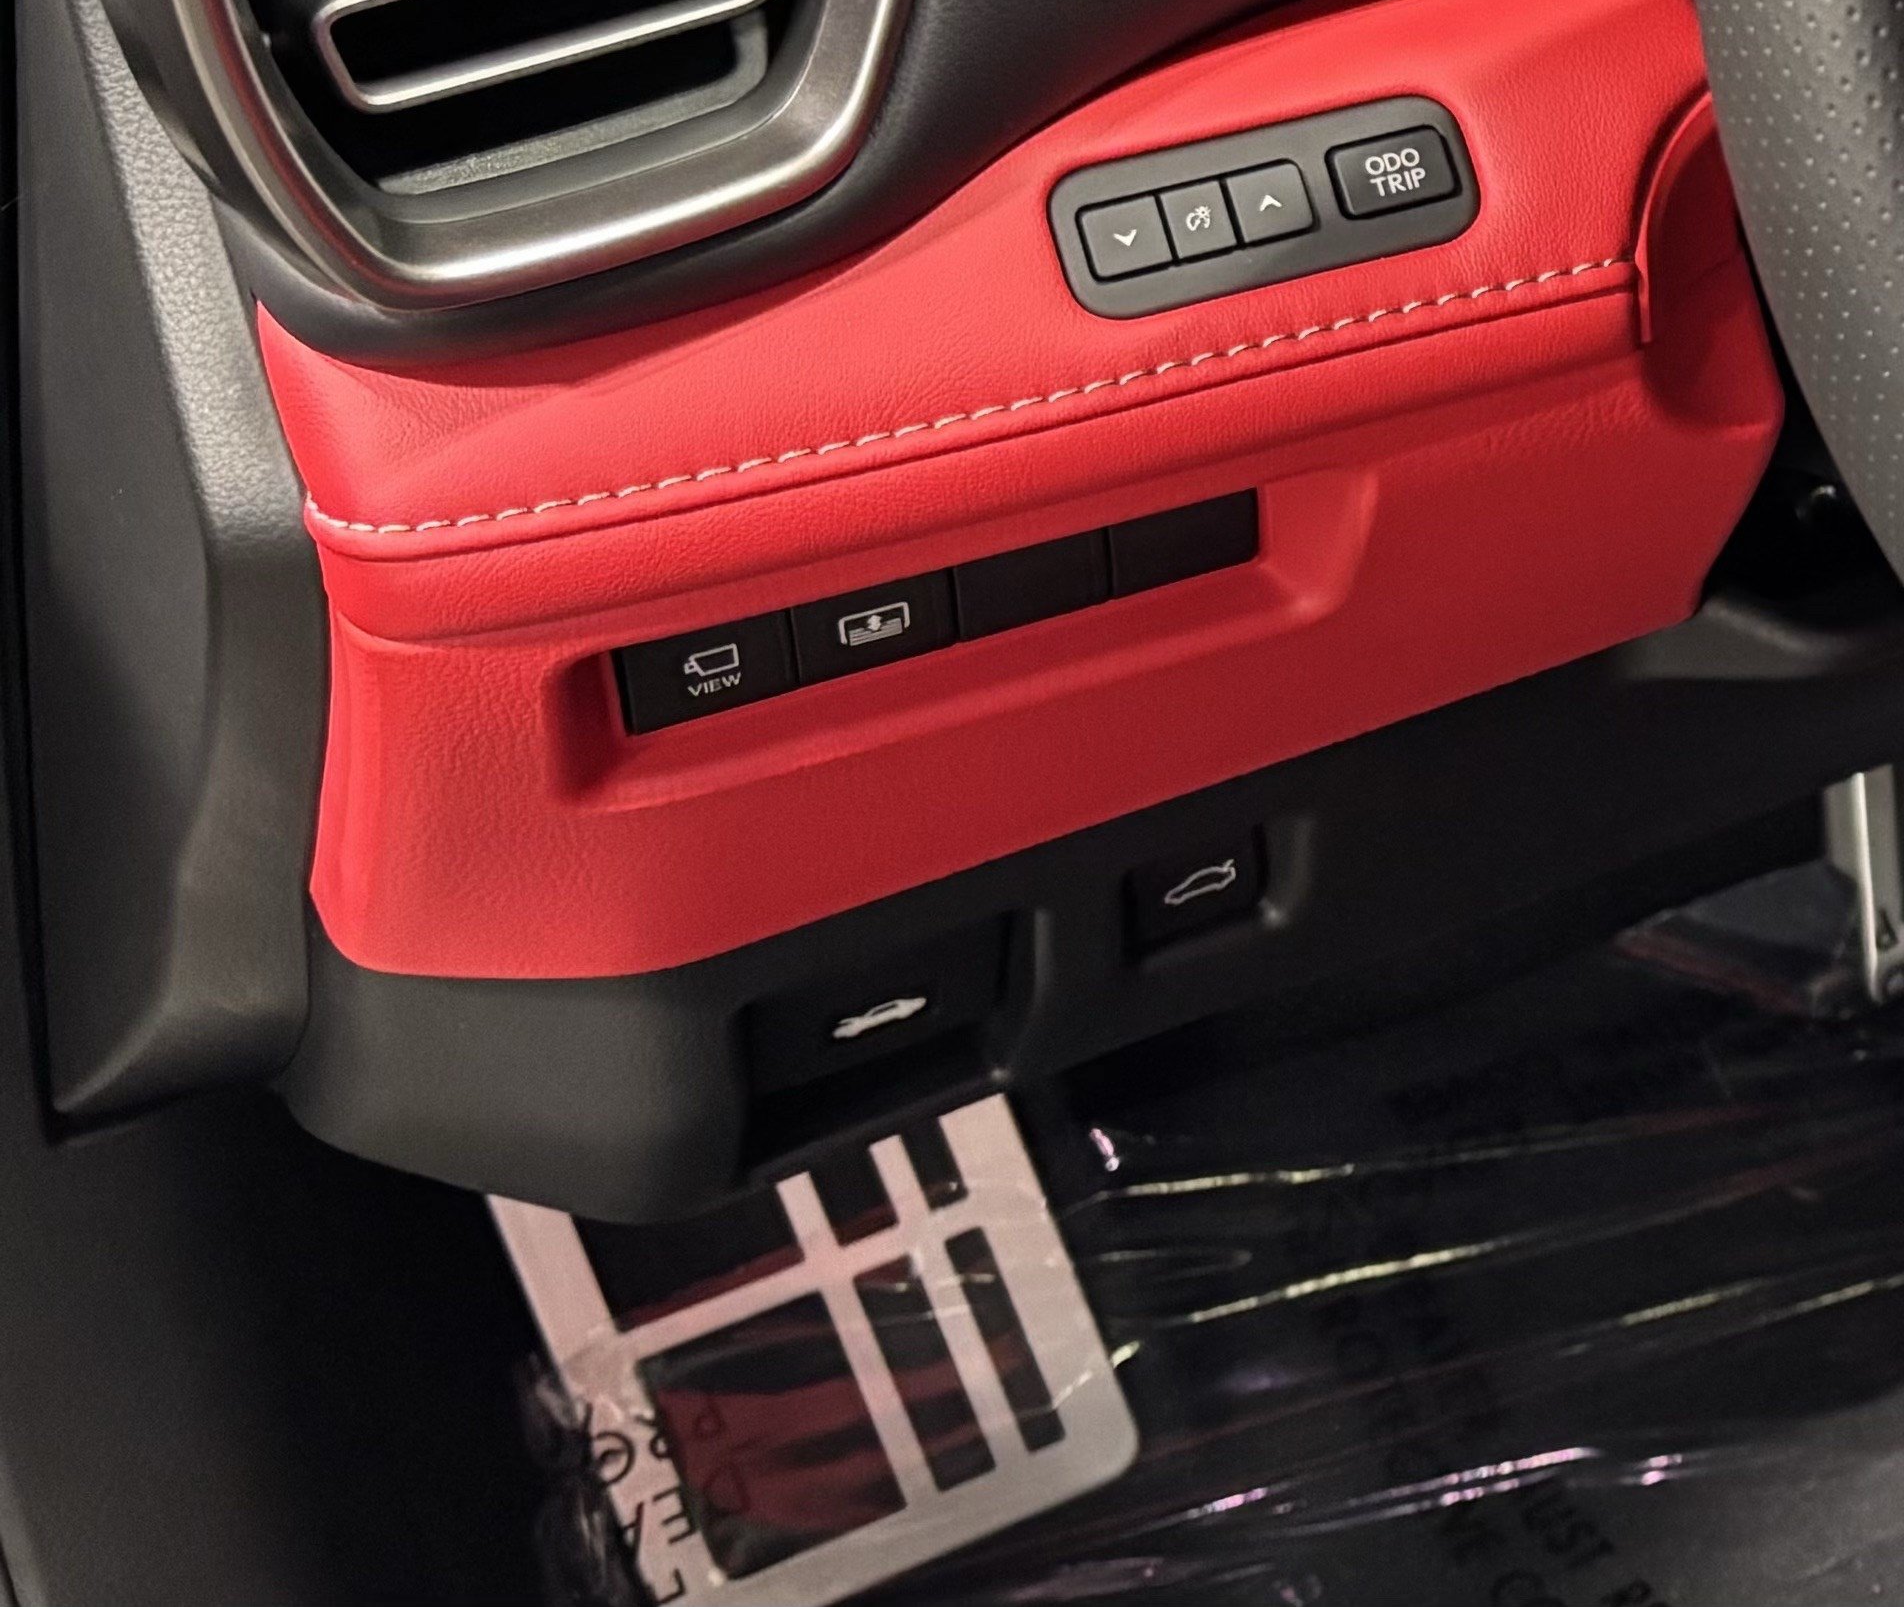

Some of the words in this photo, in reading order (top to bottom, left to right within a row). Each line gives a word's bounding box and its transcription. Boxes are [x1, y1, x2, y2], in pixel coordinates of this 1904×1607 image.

[1364, 146, 1420, 177] ODO
[1369, 167, 1427, 198] TRIP
[686, 671, 742, 697] VIEW
